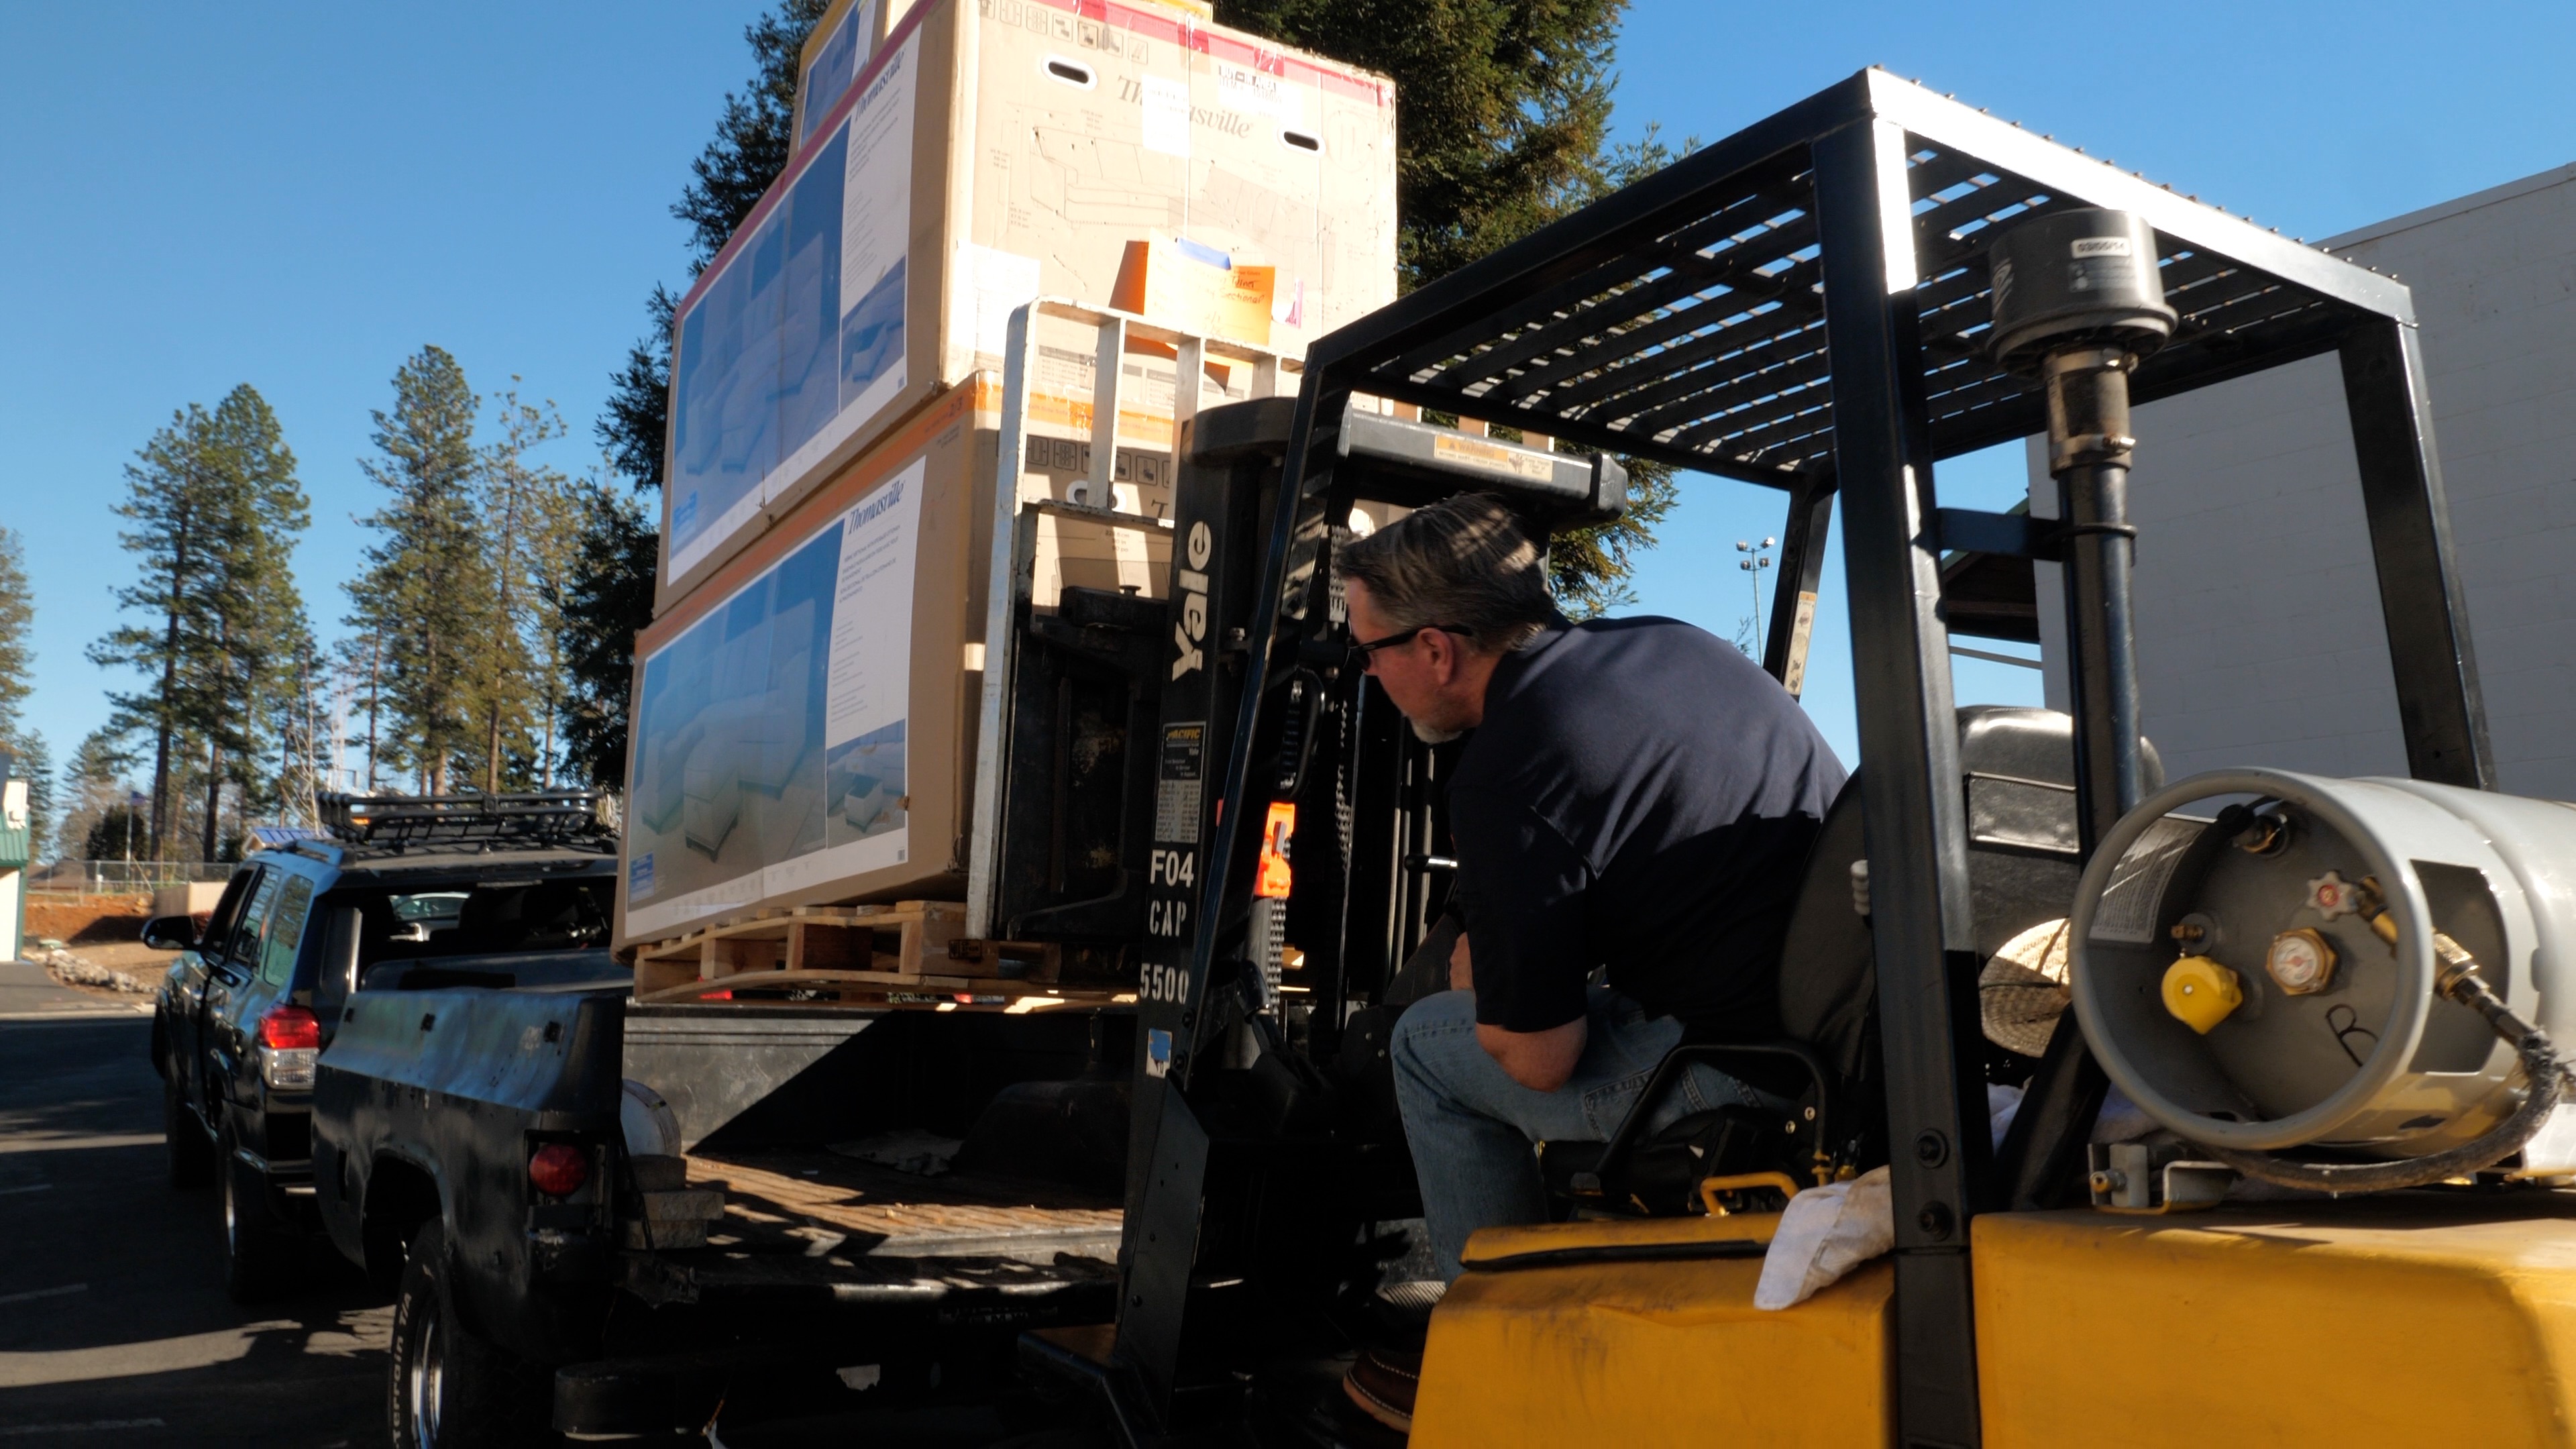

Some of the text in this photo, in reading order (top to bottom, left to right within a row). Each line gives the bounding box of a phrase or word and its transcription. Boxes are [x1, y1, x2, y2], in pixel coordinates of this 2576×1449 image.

[855, 51, 904, 123] Thomasville
[848, 480, 904, 535] Thomasville
[1172, 521, 1212, 682] Yale
[1150, 849, 1194, 888] F04
[1149, 900, 1187, 936] CAP
[1140, 963, 1189, 1004] 5500
